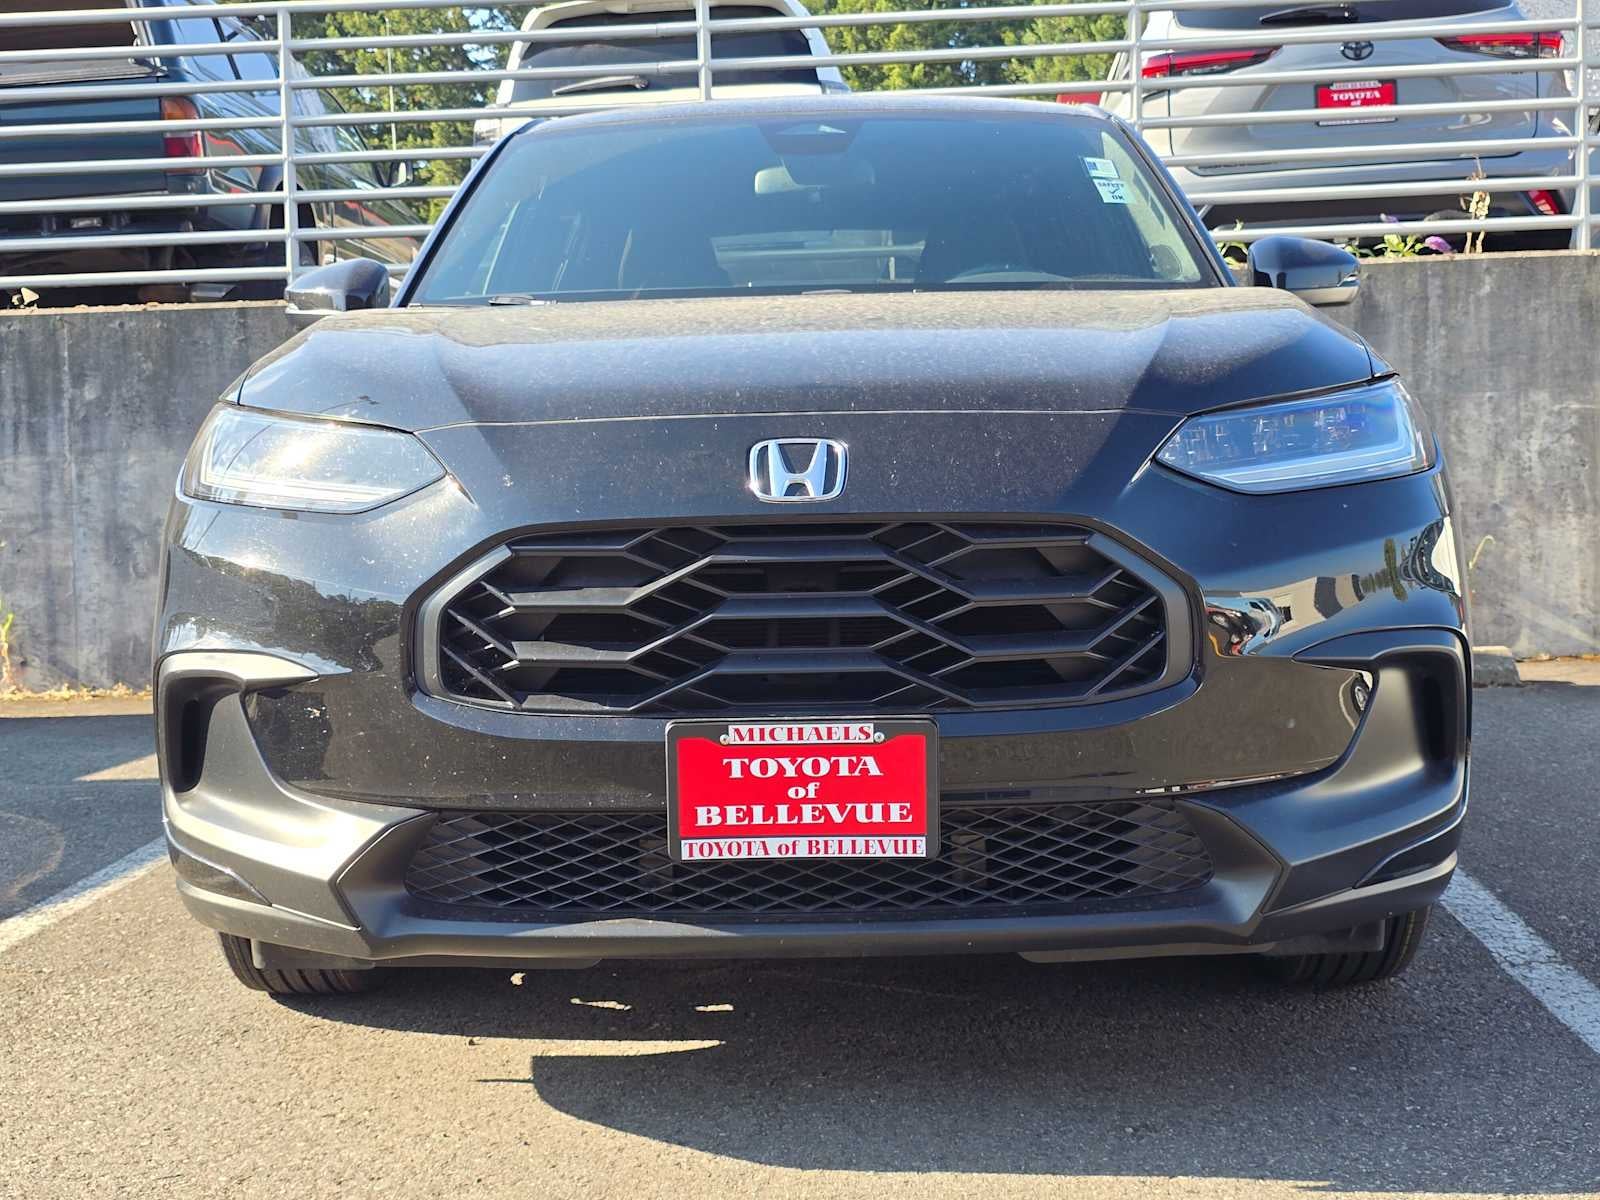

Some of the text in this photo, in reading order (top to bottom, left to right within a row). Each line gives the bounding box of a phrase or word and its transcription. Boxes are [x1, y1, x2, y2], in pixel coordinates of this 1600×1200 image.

[1331, 90, 1381, 101] TOYOTA
[732, 725, 872, 743] MICHAELS
[722, 755, 883, 779] TOYOTA
[787, 782, 821, 800] of
[694, 802, 913, 827] BELLEVUE
[683, 838, 924, 858] TOYOTA of BELLEVUE
